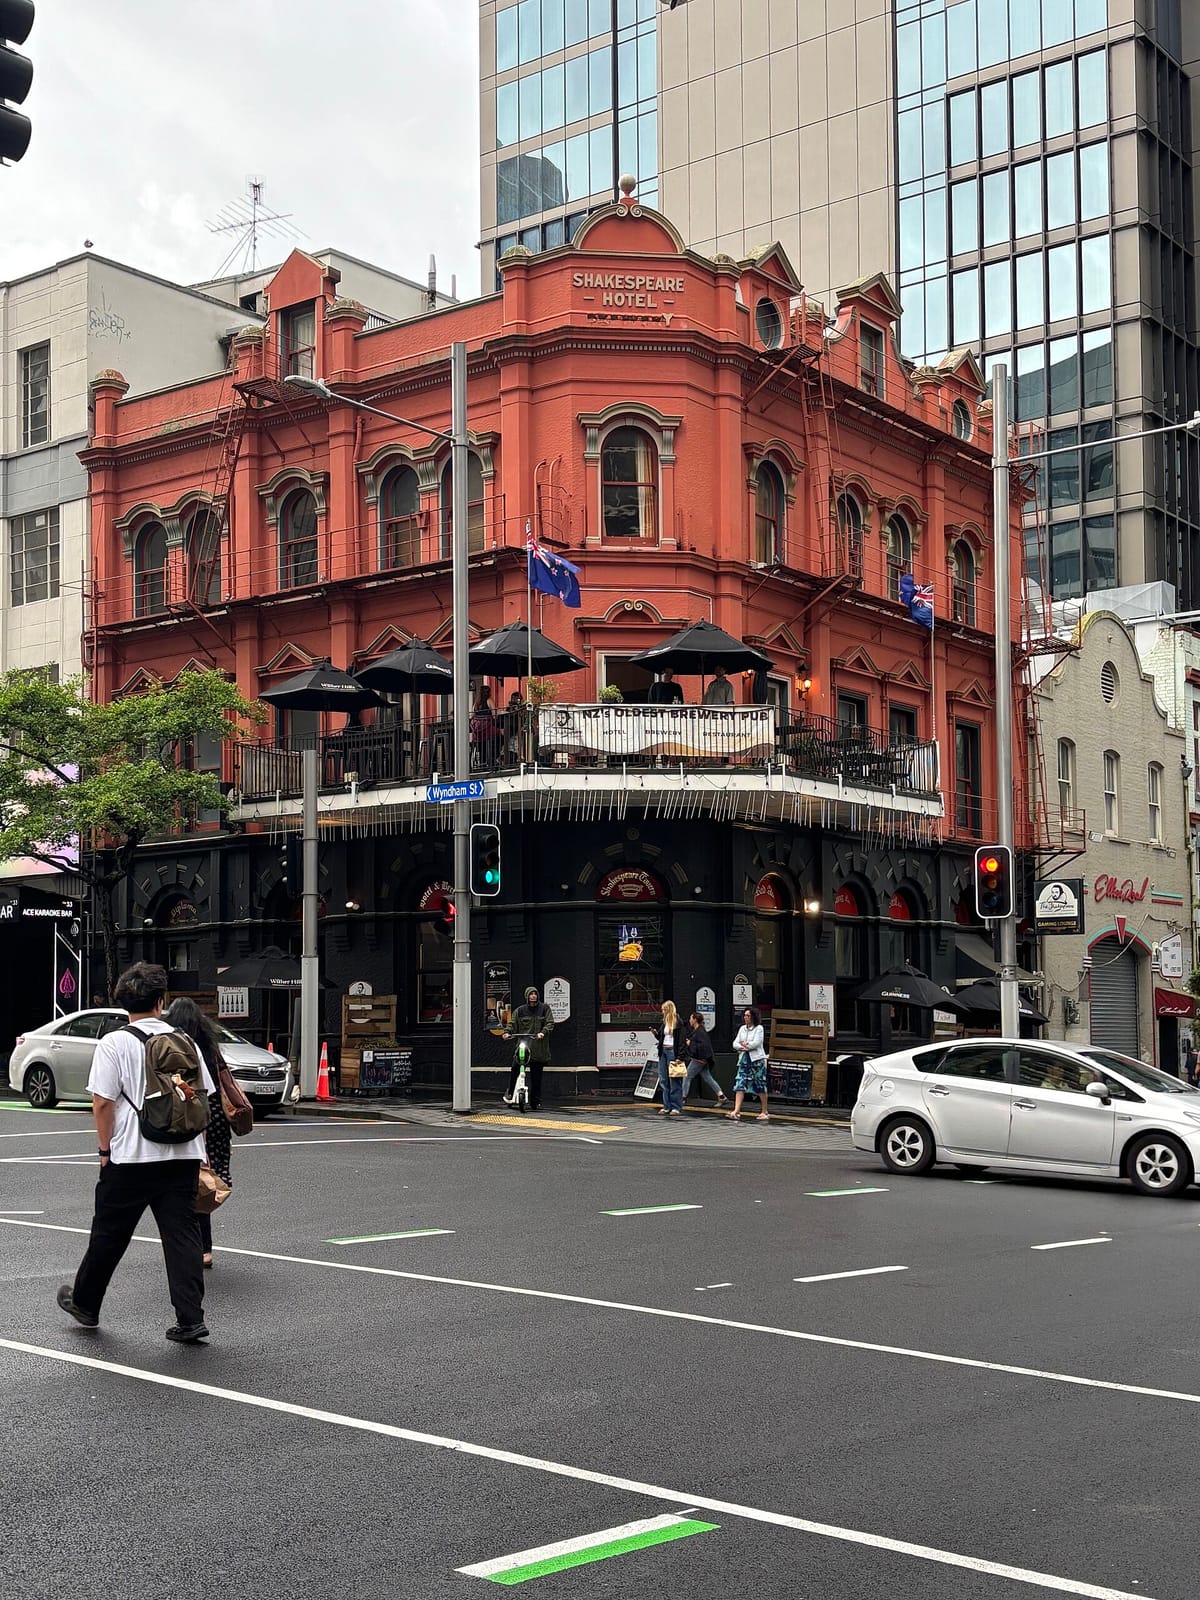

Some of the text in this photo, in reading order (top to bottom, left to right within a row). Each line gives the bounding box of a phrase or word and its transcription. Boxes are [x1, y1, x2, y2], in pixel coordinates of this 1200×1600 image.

[573, 272, 685, 292] SHAKESPEARE
[602, 292, 657, 308] HOTEL
[582, 707, 769, 721] NZ's OLDEST BREWERY PUB
[432, 782, 478, 799] Wyndham St
[600, 872, 639, 897] Shakespeare
[22, 908, 35, 916] ACE
[35, 908, 61, 917] KARAOKE
[881, 990, 910, 999] GUINNESS
